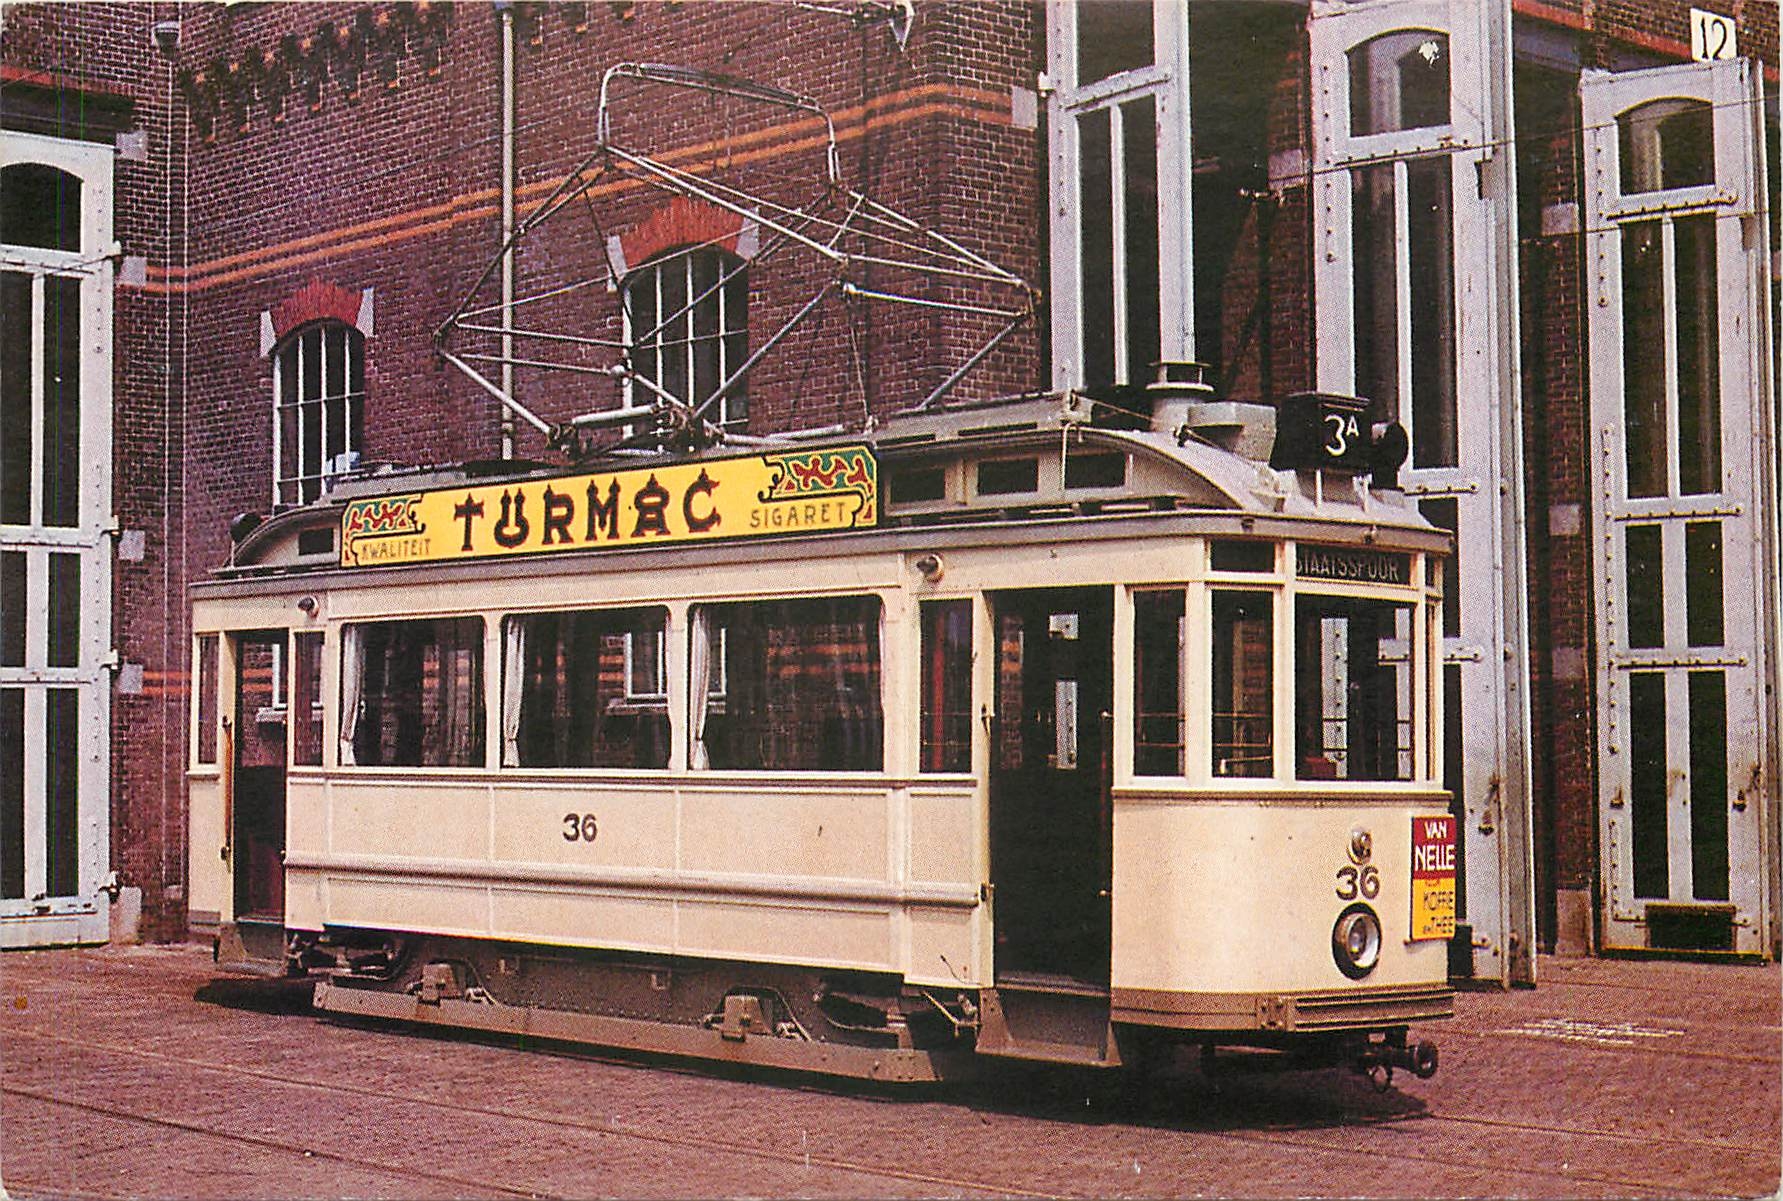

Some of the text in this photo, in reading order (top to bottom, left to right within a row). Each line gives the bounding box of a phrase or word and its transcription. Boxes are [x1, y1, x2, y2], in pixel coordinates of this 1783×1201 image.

[1702, 18, 1727, 61] 12
[750, 502, 845, 528] SIGARET
[361, 538, 431, 560] KWALITEIT
[563, 813, 597, 842] 36
[1424, 821, 1447, 839] VAN
[1415, 844, 1455, 871] NELLE
[1335, 865, 1380, 900] 36
